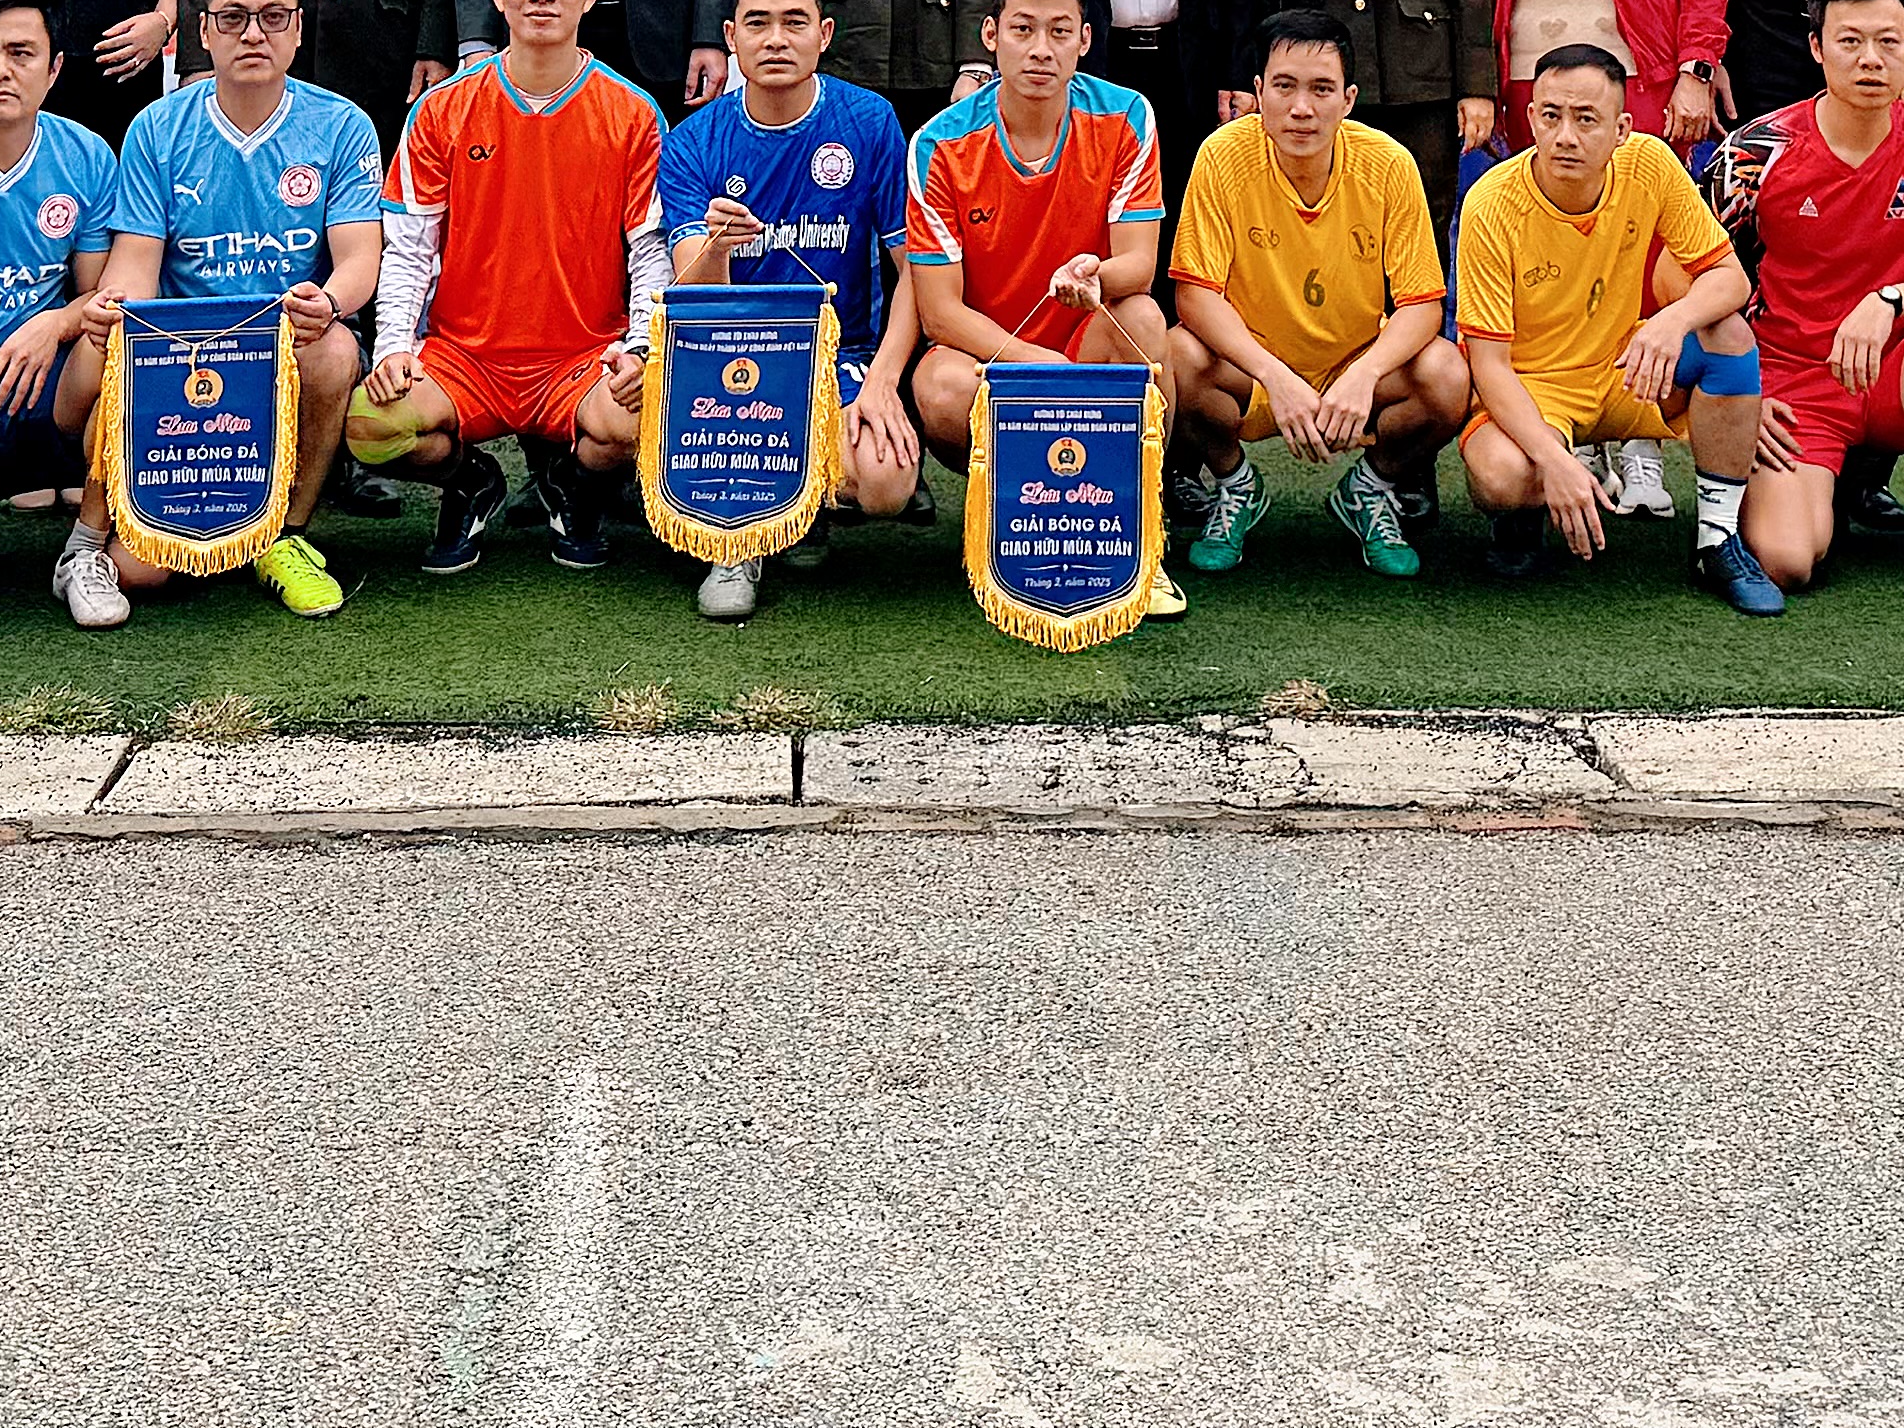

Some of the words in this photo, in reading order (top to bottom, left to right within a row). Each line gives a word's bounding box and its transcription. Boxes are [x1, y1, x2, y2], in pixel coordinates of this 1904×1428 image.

[177, 227, 319, 259] ETIHAD
[798, 213, 851, 255] University
[1302, 268, 1327, 308] 6
[680, 428, 713, 447] GIẢI
[716, 429, 763, 448] BÓNG
[767, 431, 790, 449] ĐÁ
[147, 445, 182, 462] GIẢI
[186, 443, 233, 461] BÓNG
[237, 442, 259, 460] ĐÁ
[671, 453, 699, 470] GIAO
[138, 468, 169, 486] GIAO
[1009, 513, 1044, 533] GIẢI
[1048, 514, 1096, 533] BÓNG
[1099, 515, 1123, 534] ĐÁ
[1000, 540, 1031, 557] GIAO
